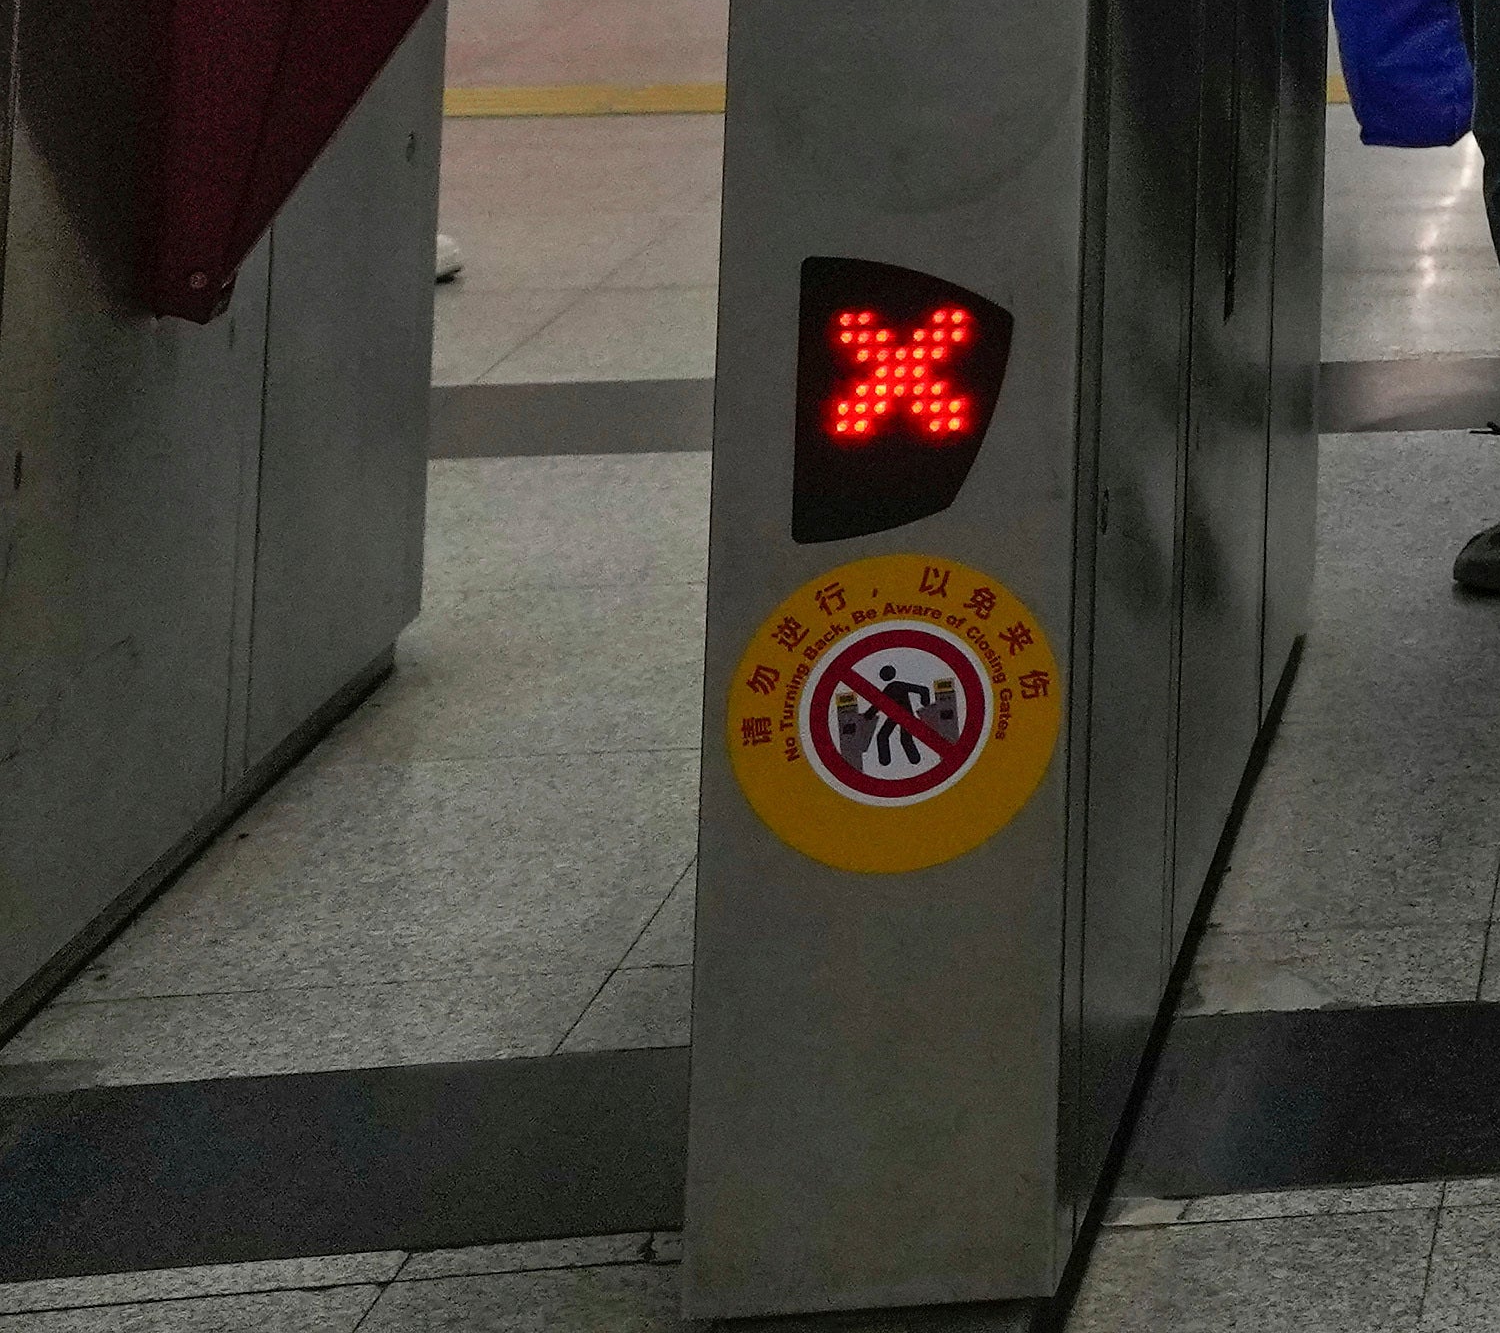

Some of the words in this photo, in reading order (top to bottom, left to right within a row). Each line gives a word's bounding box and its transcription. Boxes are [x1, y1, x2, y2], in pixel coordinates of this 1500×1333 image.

[851, 607, 879, 626] Be
[882, 601, 943, 620] Aware
[946, 613, 965, 629] of
[966, 625, 1008, 685] Closing
[779, 662, 811, 731] Turning
[994, 688, 1014, 742] Gates
[784, 737, 801, 763] No
